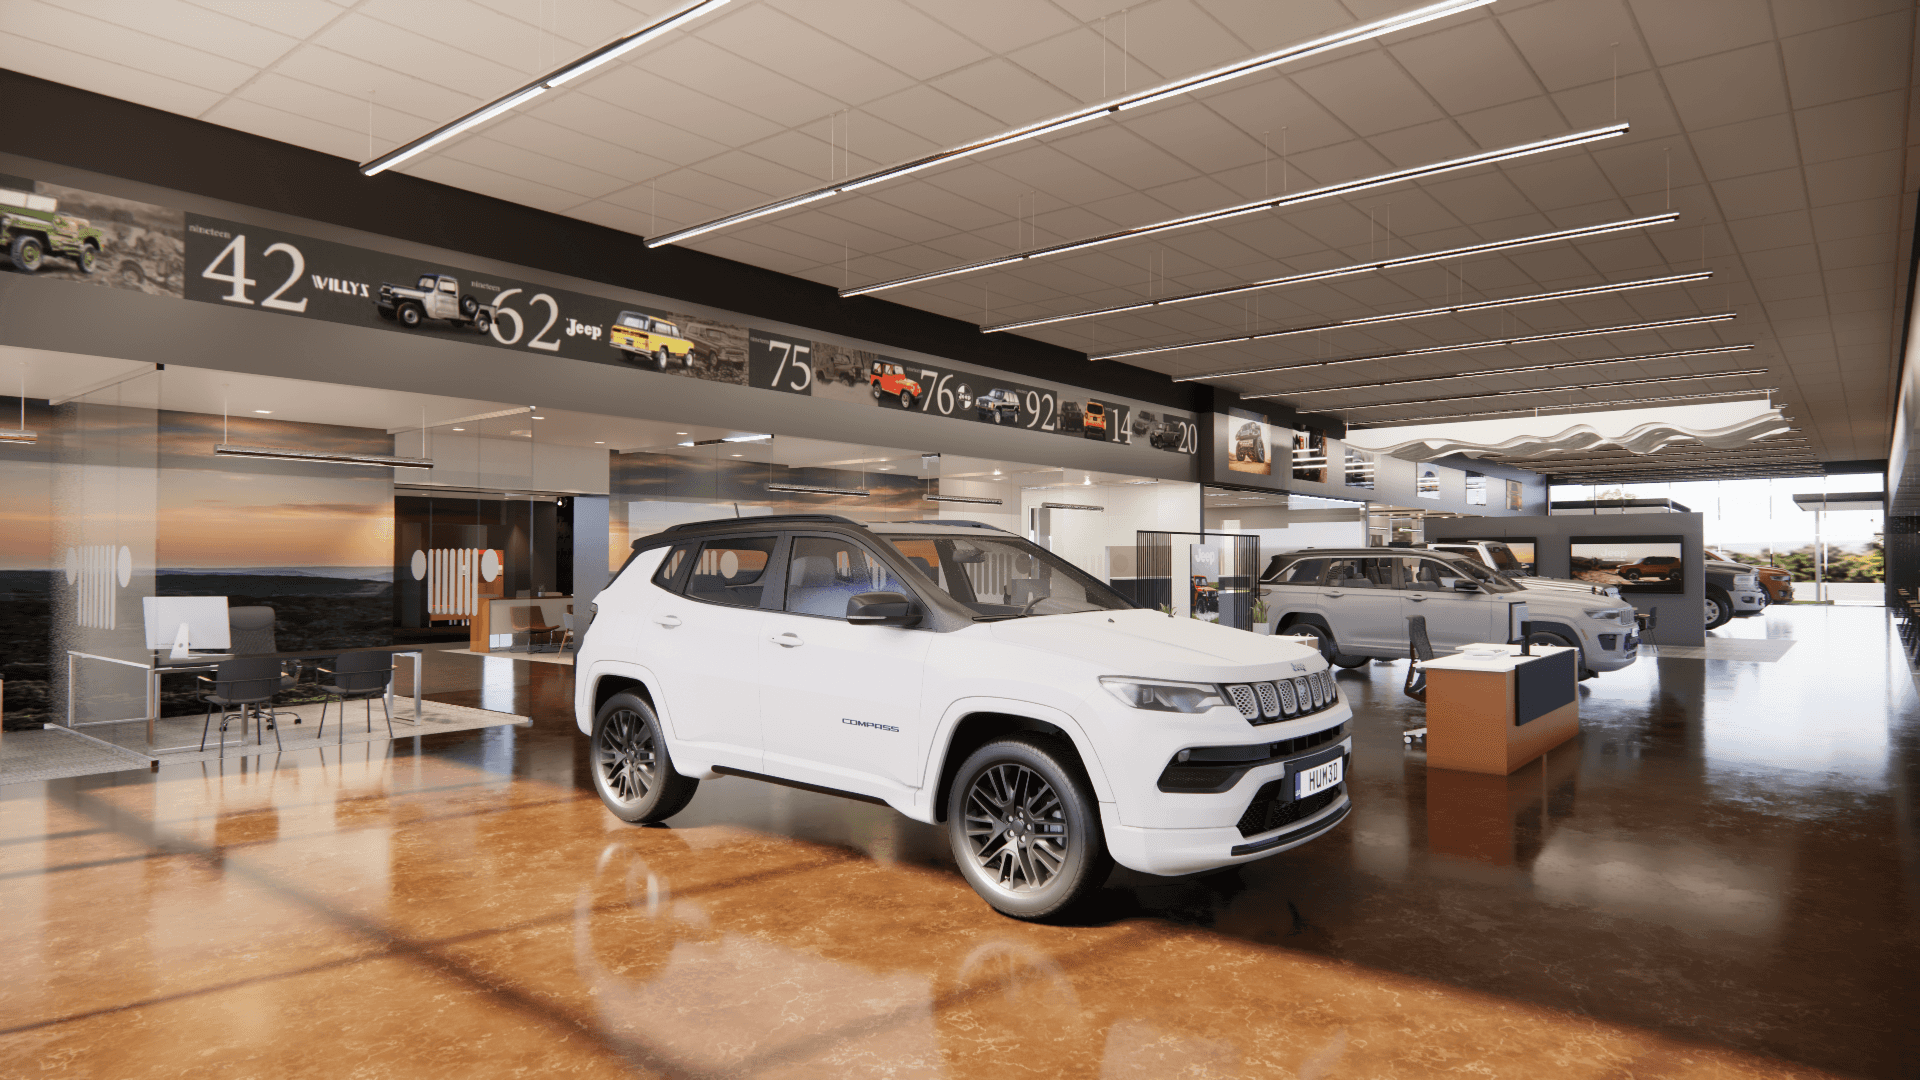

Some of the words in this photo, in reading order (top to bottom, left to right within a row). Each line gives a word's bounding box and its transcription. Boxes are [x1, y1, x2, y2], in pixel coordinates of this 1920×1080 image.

[202, 234, 308, 313] 42
[311, 274, 370, 298] WILLYS
[489, 288, 561, 351] 62
[565, 318, 603, 341] Jeep
[768, 339, 811, 391] 75
[920, 369, 954, 415] 76
[1026, 390, 1055, 431] 92
[1112, 408, 1133, 444] 14
[1177, 421, 1198, 455] 20
[842, 718, 900, 733] COMPASS
[1309, 762, 1338, 791] HUM3D
